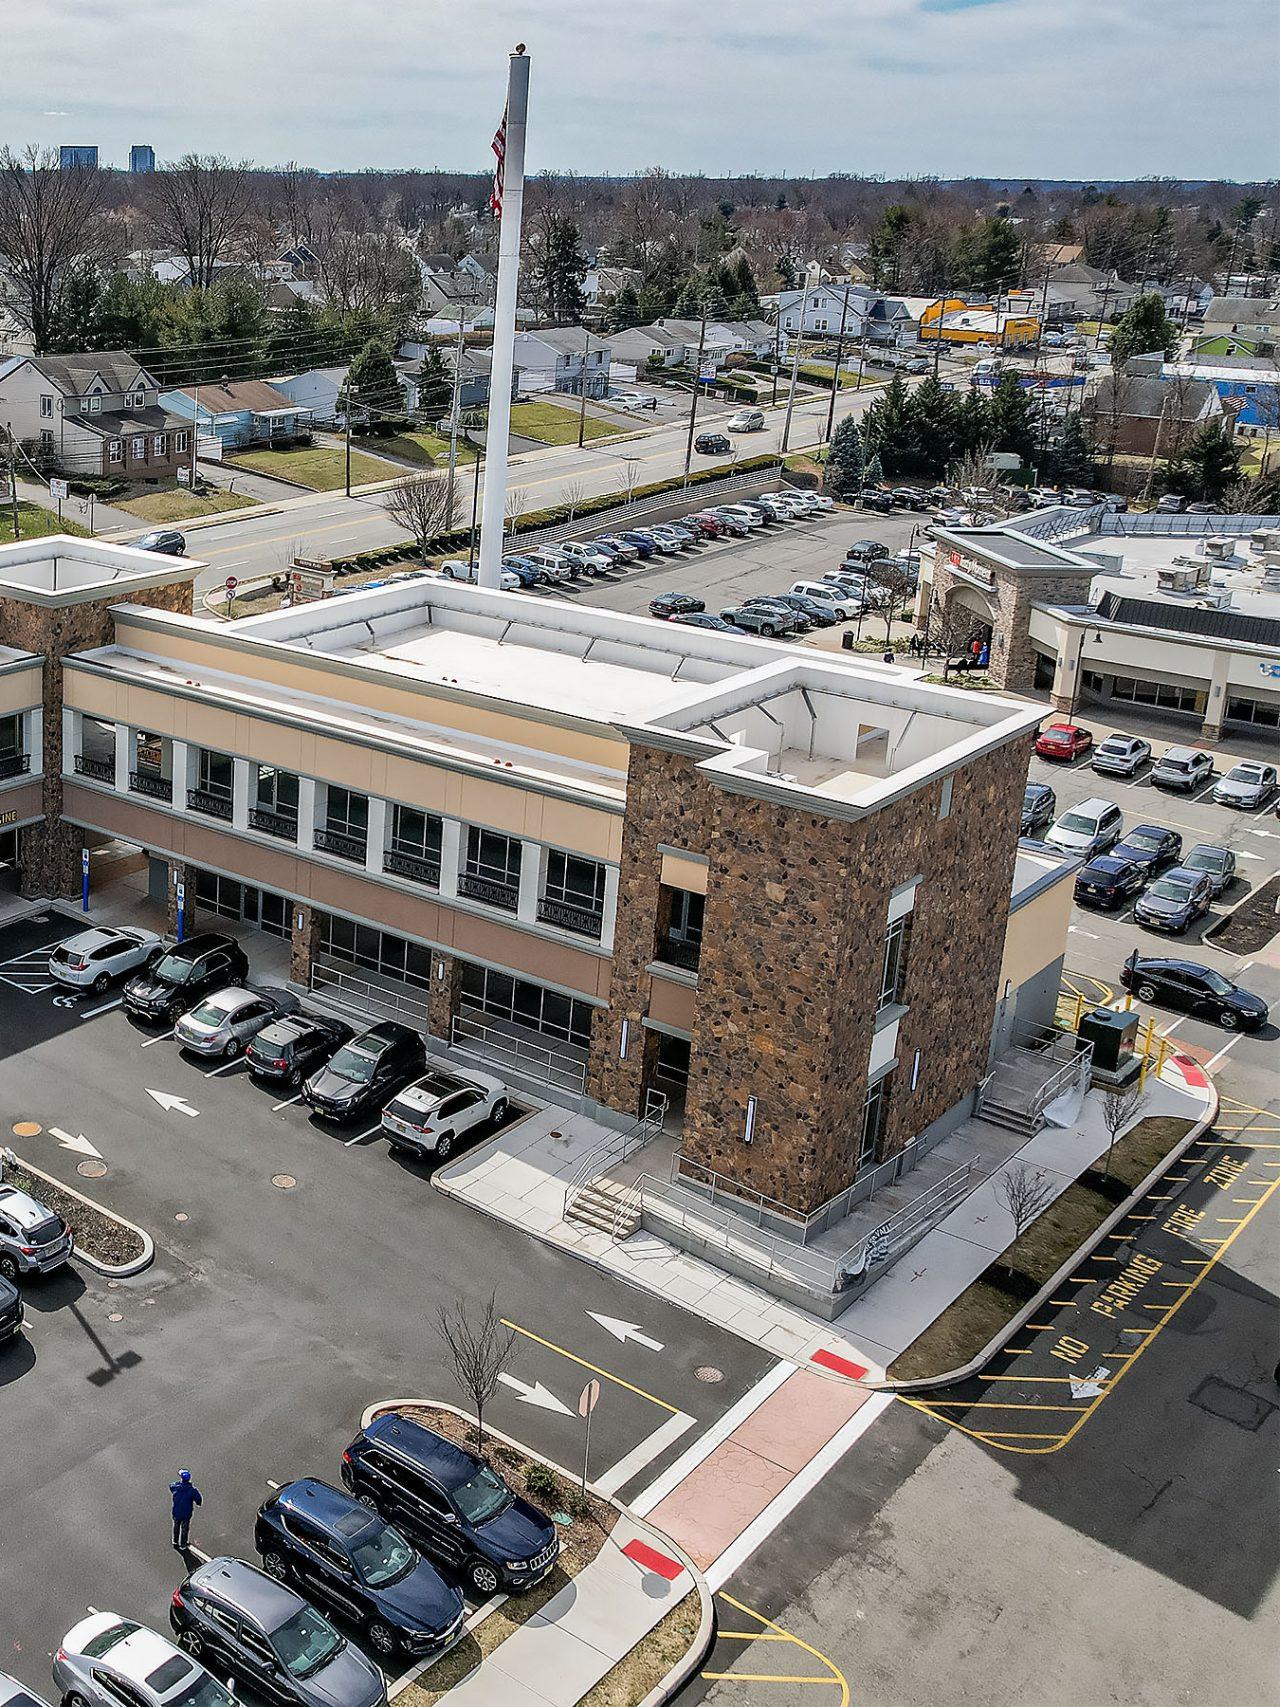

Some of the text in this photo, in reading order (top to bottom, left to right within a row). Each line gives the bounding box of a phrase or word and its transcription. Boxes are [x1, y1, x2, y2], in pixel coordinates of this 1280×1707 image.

[1049, 1154, 1249, 1365] NO PARKING FIRE ZONE
